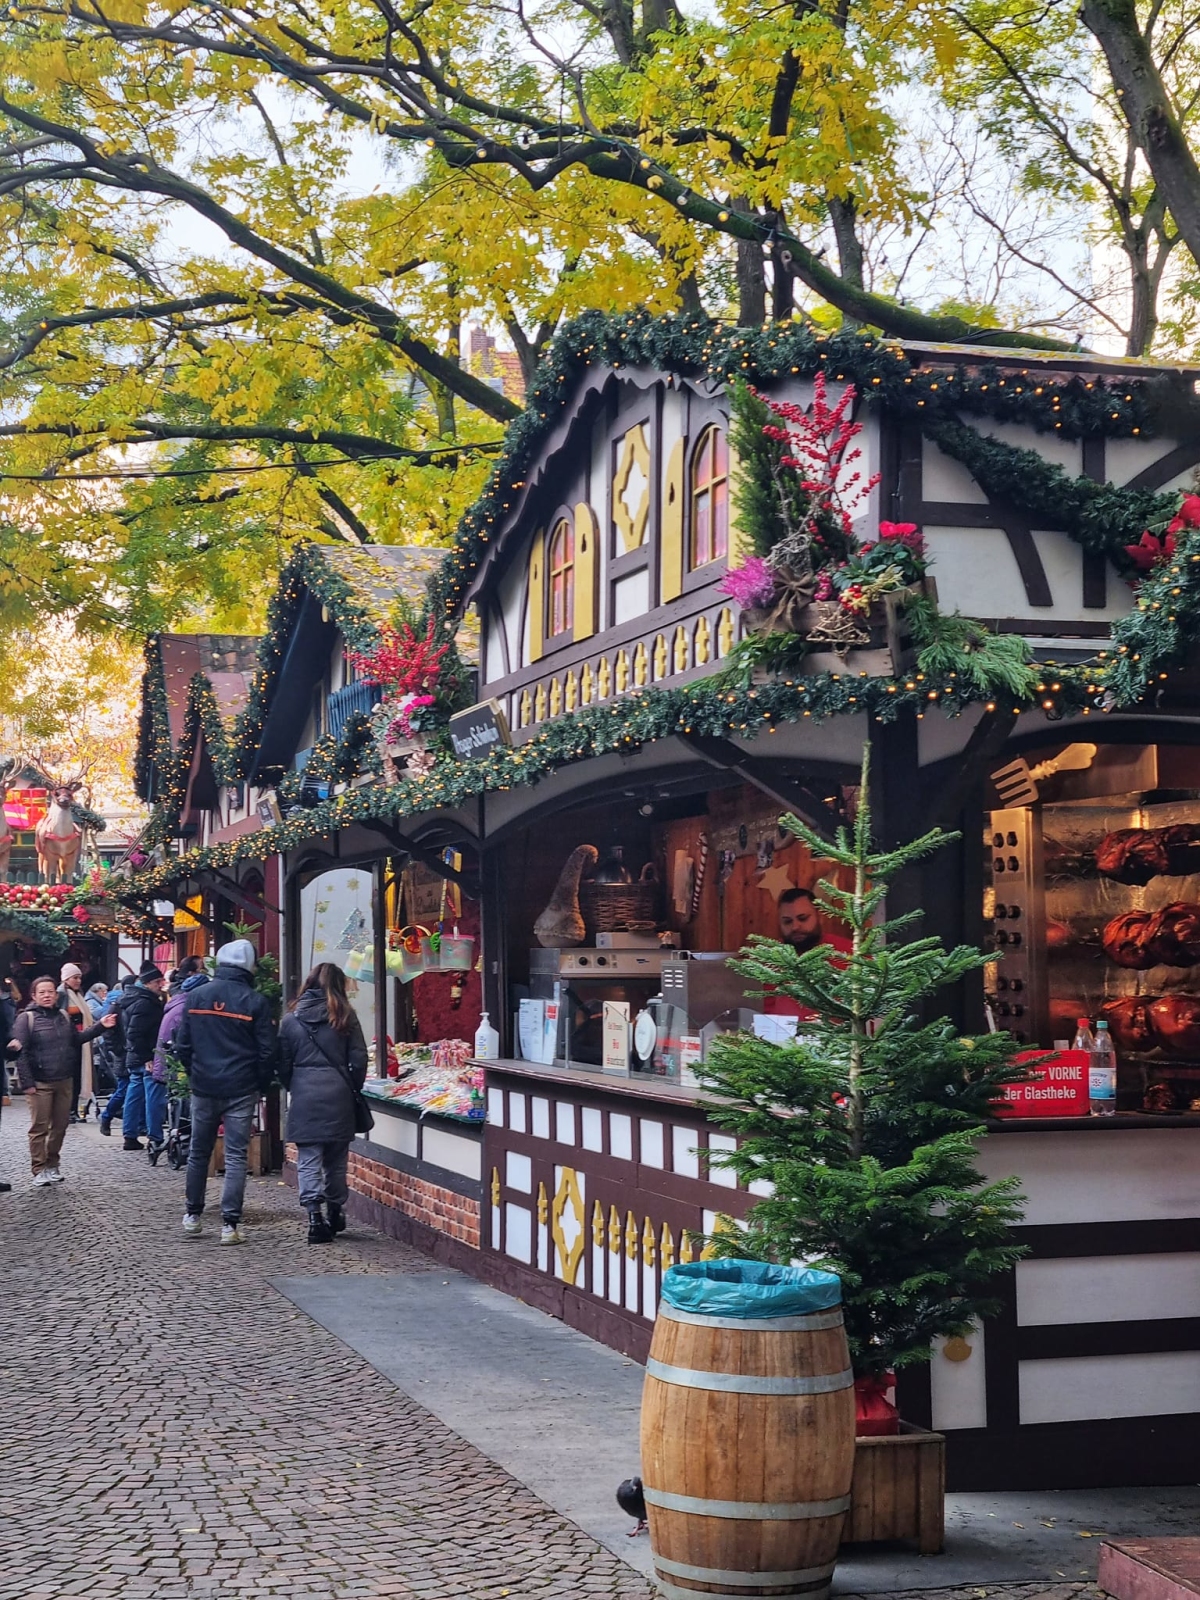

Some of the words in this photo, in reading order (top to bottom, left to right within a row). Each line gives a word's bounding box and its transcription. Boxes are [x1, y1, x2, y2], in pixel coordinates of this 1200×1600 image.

[1048, 1067, 1082, 1080] VORNE
[1004, 1087, 1022, 1100] der
[1025, 1086, 1076, 1100] Glastheke
